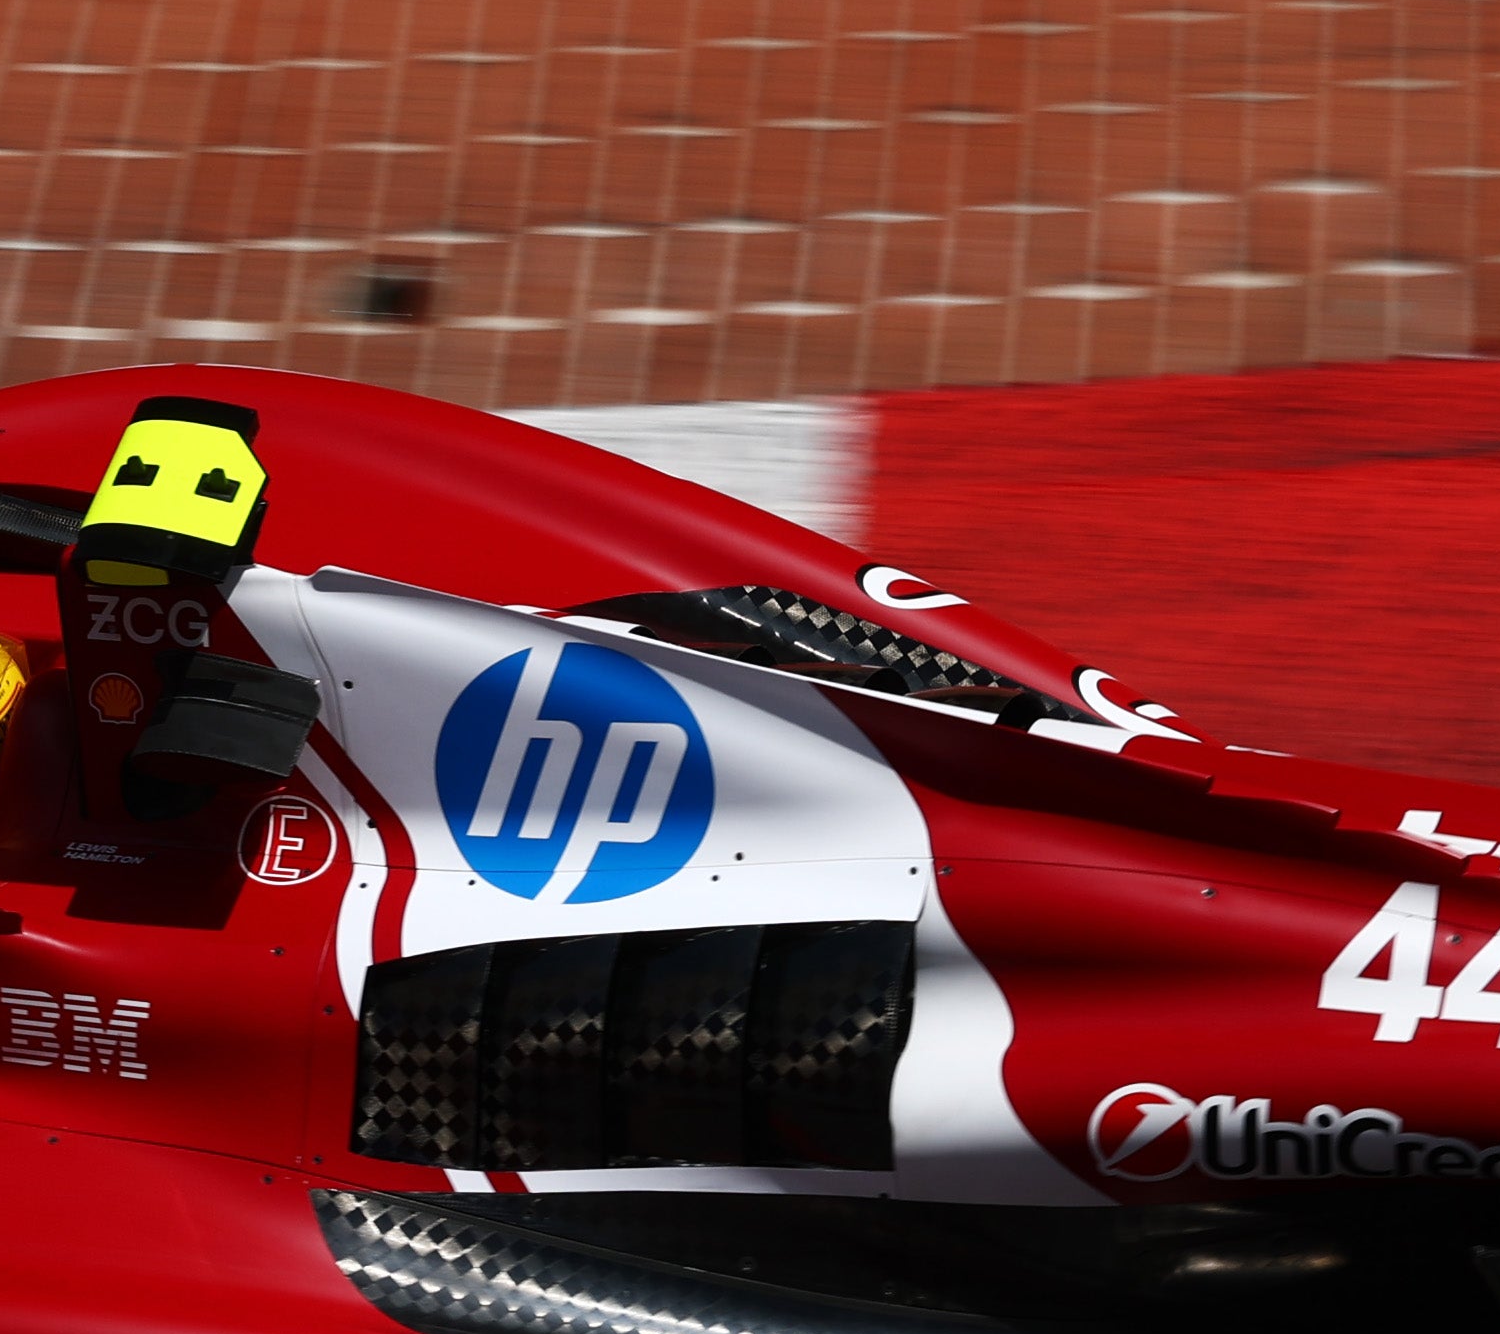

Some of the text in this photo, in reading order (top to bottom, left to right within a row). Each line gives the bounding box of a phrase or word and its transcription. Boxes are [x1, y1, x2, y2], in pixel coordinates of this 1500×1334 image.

[466, 643, 689, 904] hp
[62, 851, 146, 865] HAMILTON
[66, 841, 119, 854] LEWIS
[258, 804, 308, 880] E
